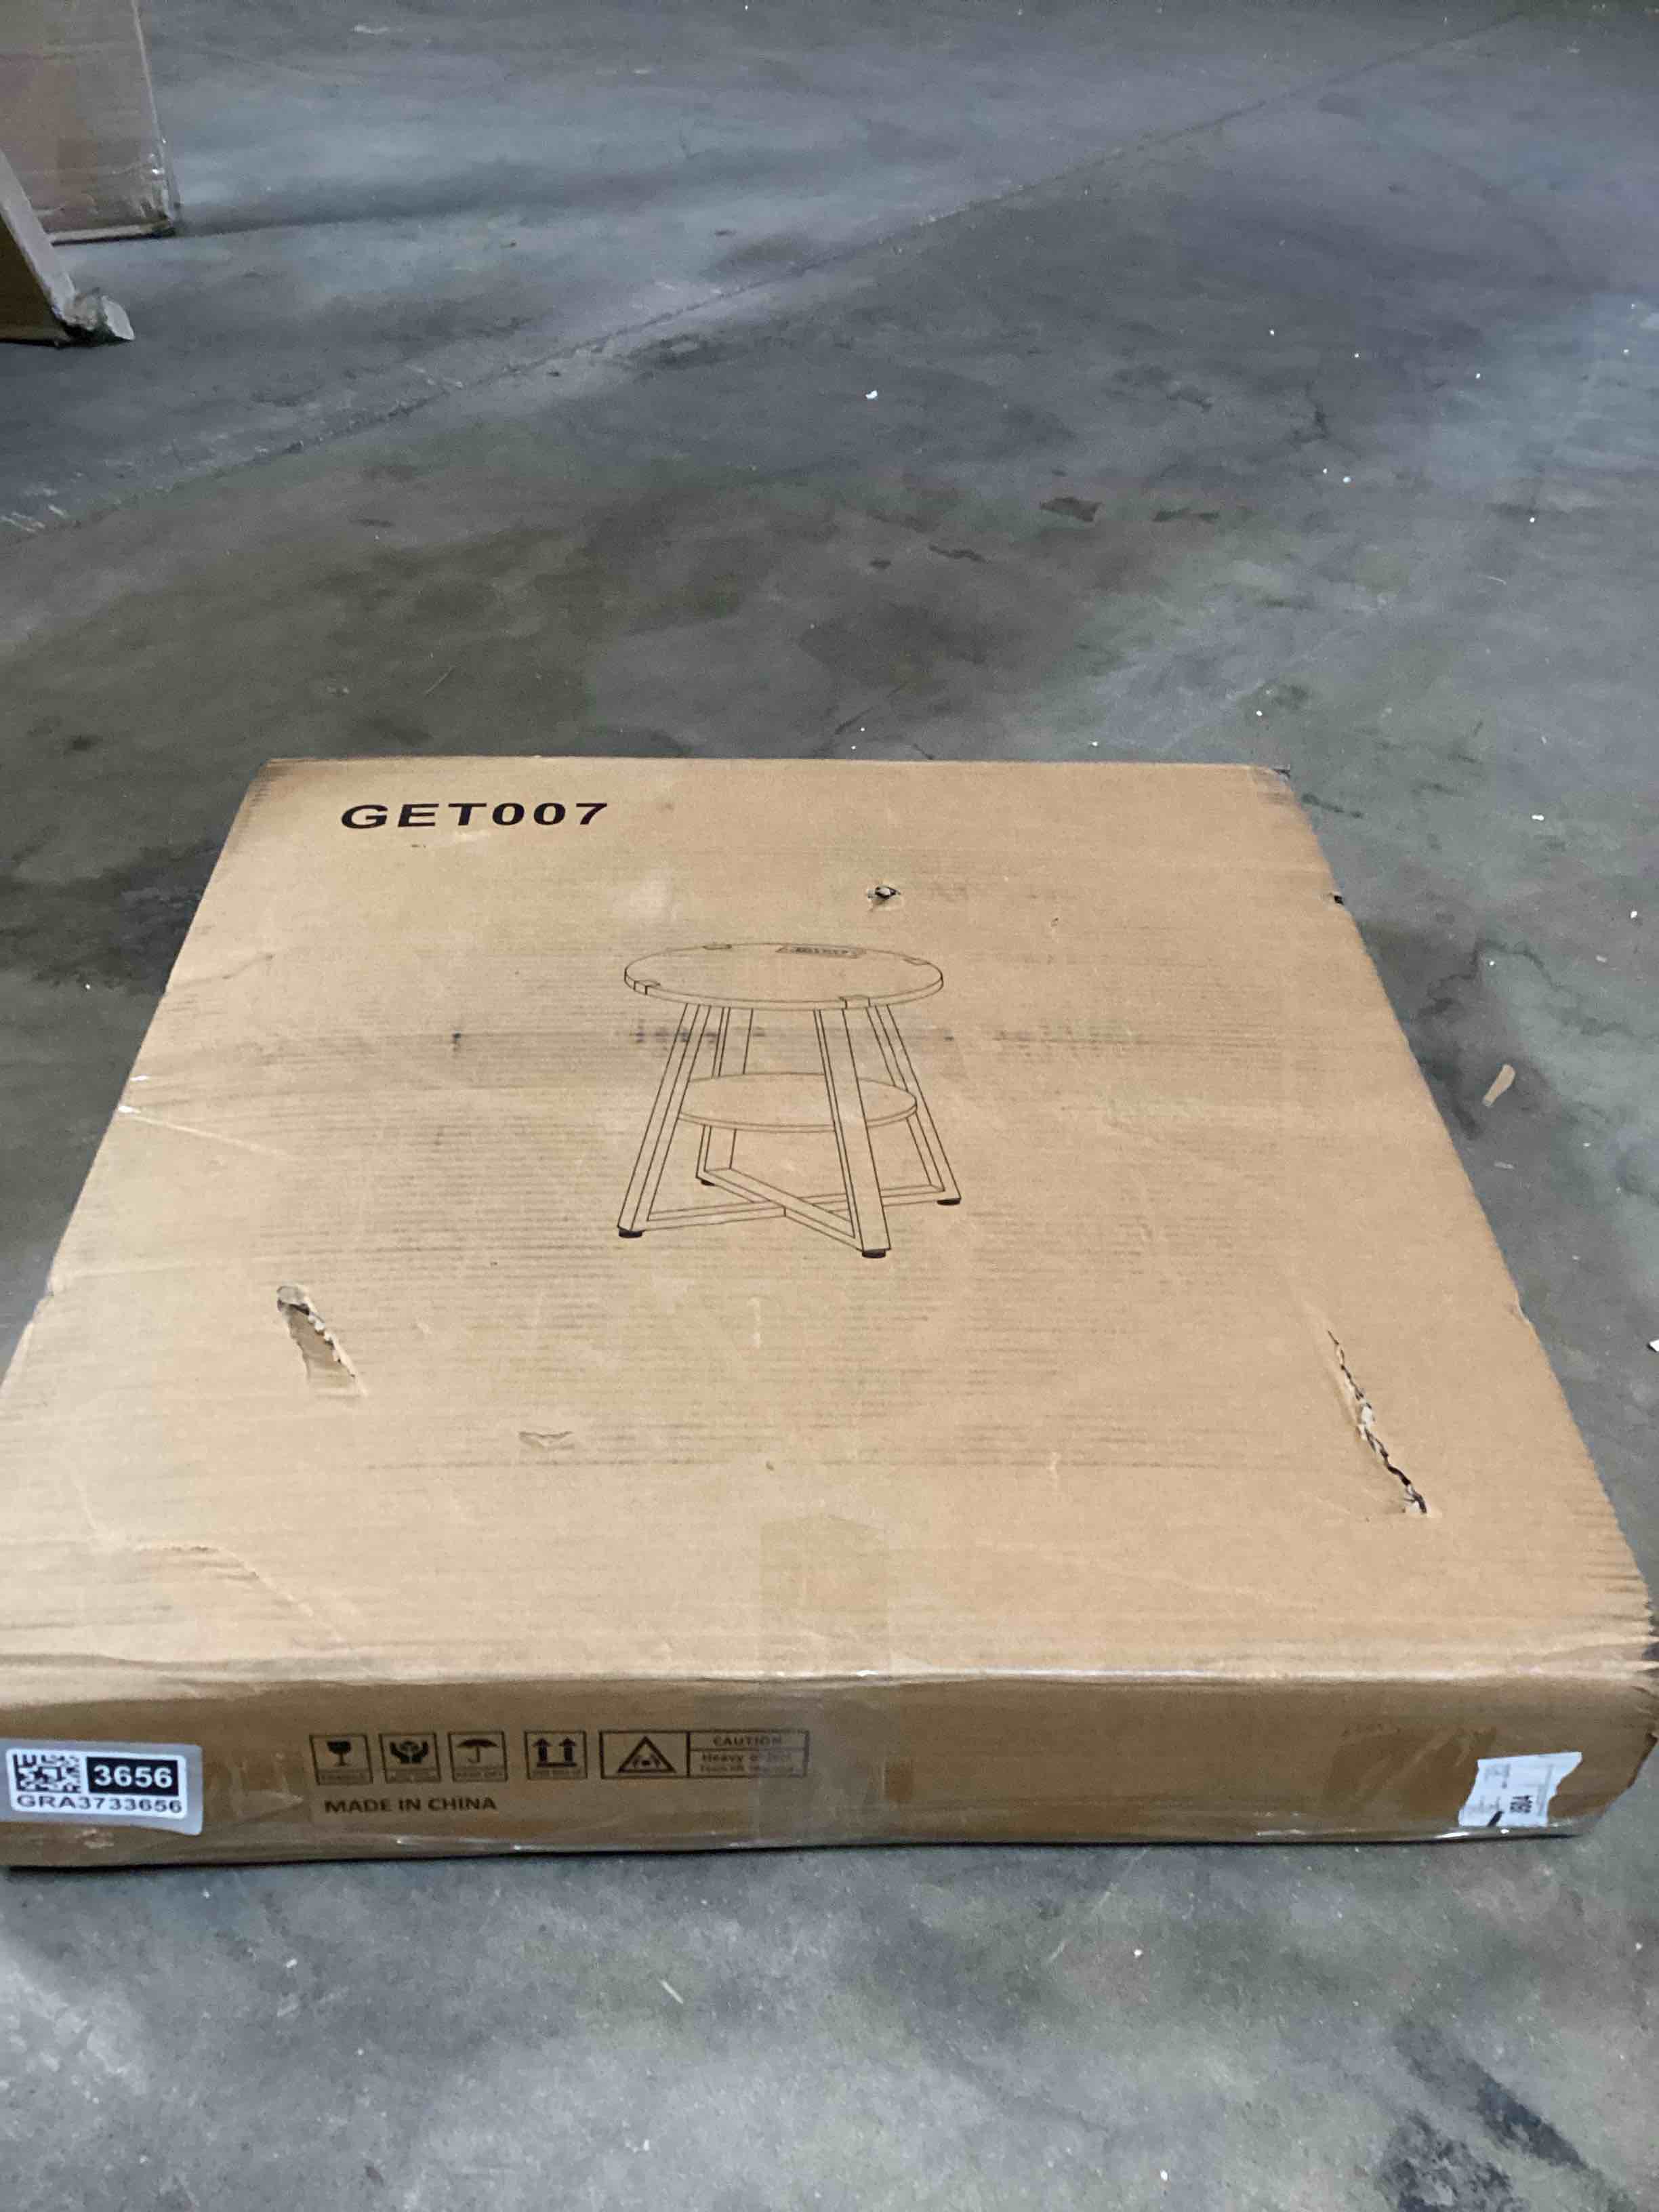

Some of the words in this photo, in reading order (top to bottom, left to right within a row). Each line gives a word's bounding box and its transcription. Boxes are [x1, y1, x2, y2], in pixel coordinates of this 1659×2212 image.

[340, 802, 607, 829] GET007
[713, 1736, 782, 1746] CAUTION
[94, 1765, 173, 1788] 3656
[16, 1795, 182, 1813] GRA3733656
[324, 1799, 392, 1813] MADE
[398, 1798, 422, 1811] IN
[428, 1796, 497, 1811] CHINA
